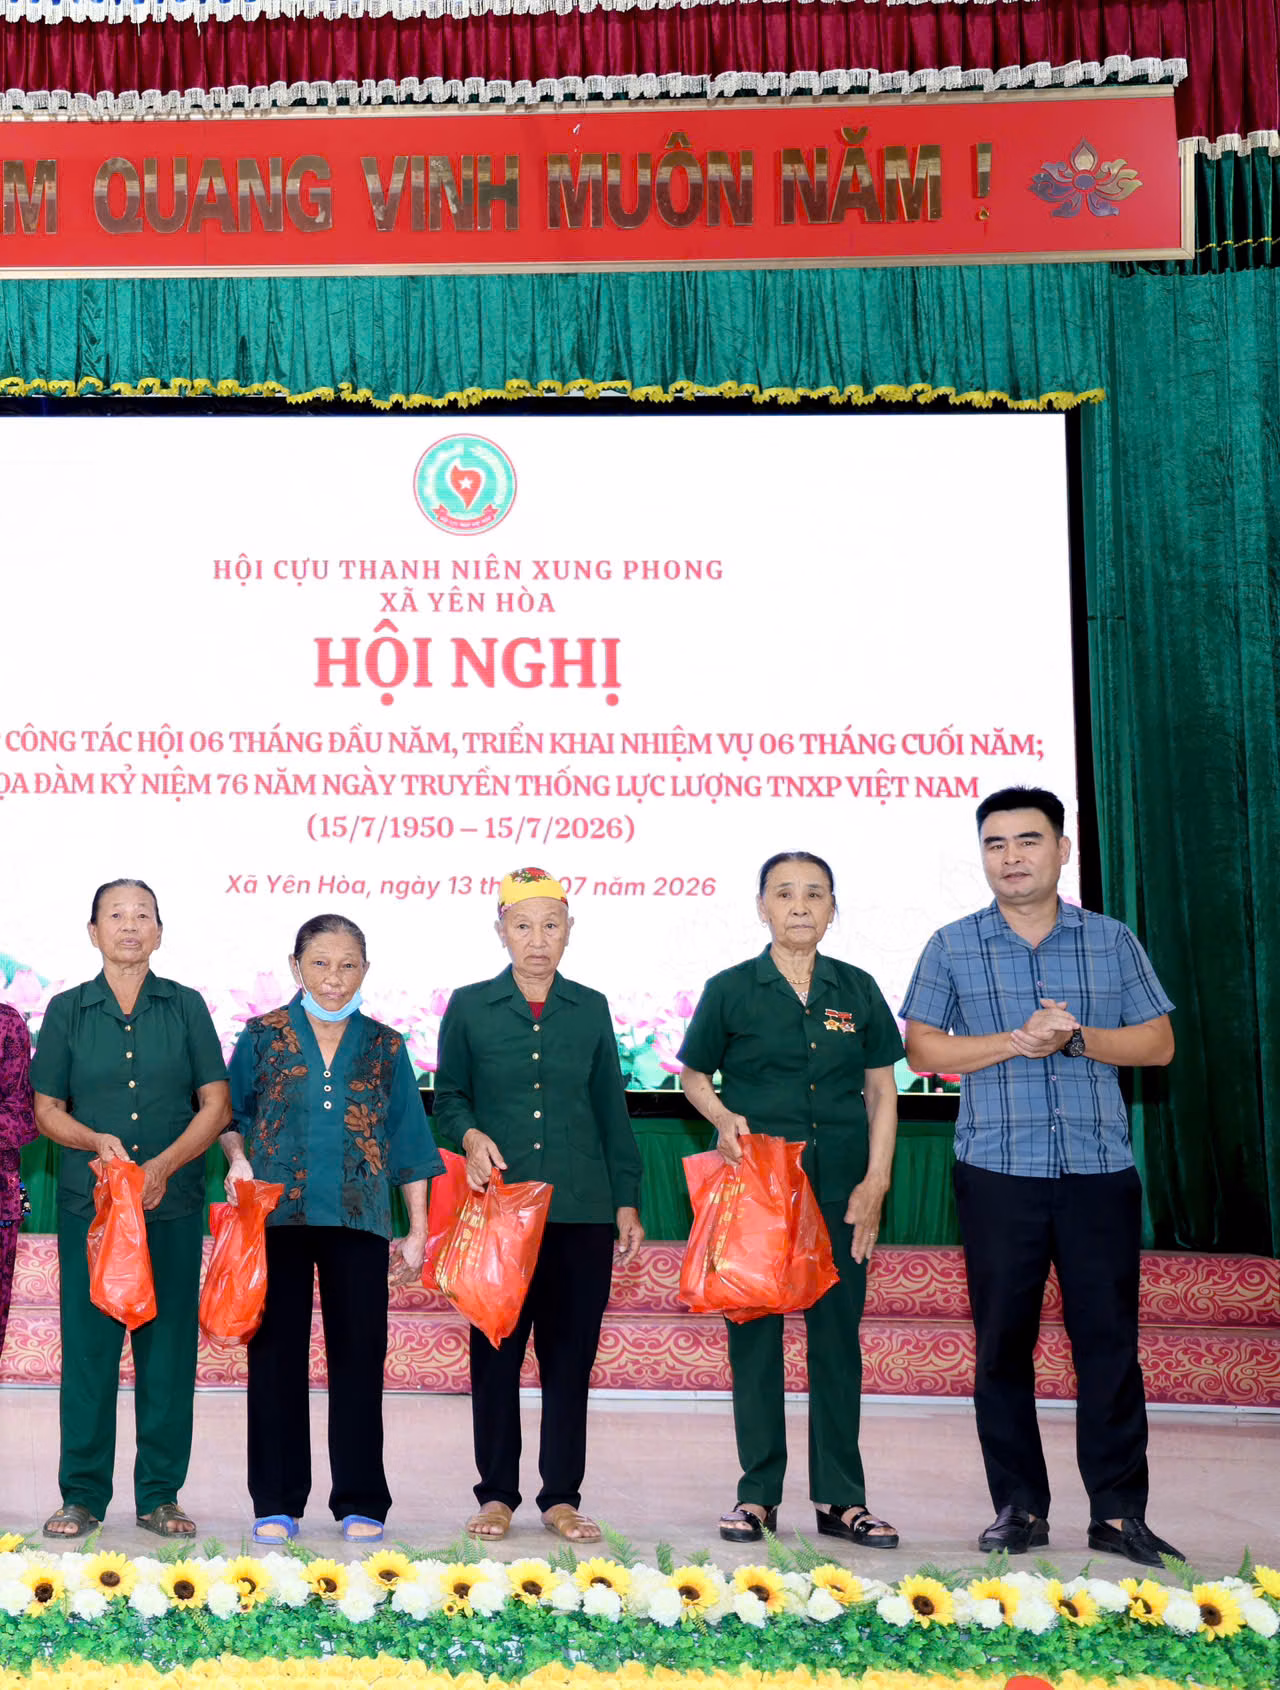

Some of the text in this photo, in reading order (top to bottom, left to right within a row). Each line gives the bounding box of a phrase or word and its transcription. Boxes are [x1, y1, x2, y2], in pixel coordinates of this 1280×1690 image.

[93, 155, 333, 234] QUANG
[360, 155, 520, 232] VINH
[547, 131, 754, 229] MUÔN
[780, 126, 943, 225] NĂM
[974, 143, 993, 221] !
[213, 553, 723, 587] HỘI CỰU THANH NIÊN XUNG PHONG
[380, 585, 556, 613] XÃ YÊN HÒA
[313, 618, 622, 707] HỘI NGHỊ
[5, 722, 77, 752] CÔNG
[81, 722, 133, 752] TÁC
[137, 723, 185, 759] HỘI
[189, 731, 224, 753] 06
[229, 723, 323, 753] THÁNG
[329, 722, 383, 753] ĐẦU
[389, 726, 459, 759] NĂM,
[462, 722, 544, 754] TRIỂN
[549, 733, 615, 754] KHAI
[620, 725, 713, 763] NHIỆM
[716, 733, 755, 762] VỤ
[759, 733, 795, 755] 06
[799, 724, 897, 755] THÁNG
[901, 724, 965, 756] CUỐI
[969, 727, 1045, 761] NĂM;
[33, 763, 95, 795] ĐÀM
[100, 763, 137, 795] KỶ
[141, 765, 212, 803] NIỆM
[216, 773, 249, 795] 76
[253, 767, 317, 796] NĂM
[322, 765, 397, 796] NGÀY
[401, 765, 511, 797] TRUYỀN
[514, 765, 611, 797] THỐNG
[615, 772, 665, 804] LỰC
[670, 772, 763, 804] LƯỢNG
[766, 775, 843, 798] TNXP
[845, 767, 910, 805] VIỆT
[914, 775, 980, 799] NAM
[307, 813, 455, 843] (15/7/1950
[484, 815, 635, 844] 15/7/2026)
[225, 875, 258, 895] Xã
[266, 875, 311, 895] Yên
[317, 874, 371, 899] Hòa,
[380, 874, 441, 902] ngày
[448, 876, 473, 895] 13
[592, 877, 645, 897] năm
[652, 877, 718, 897] 2026
